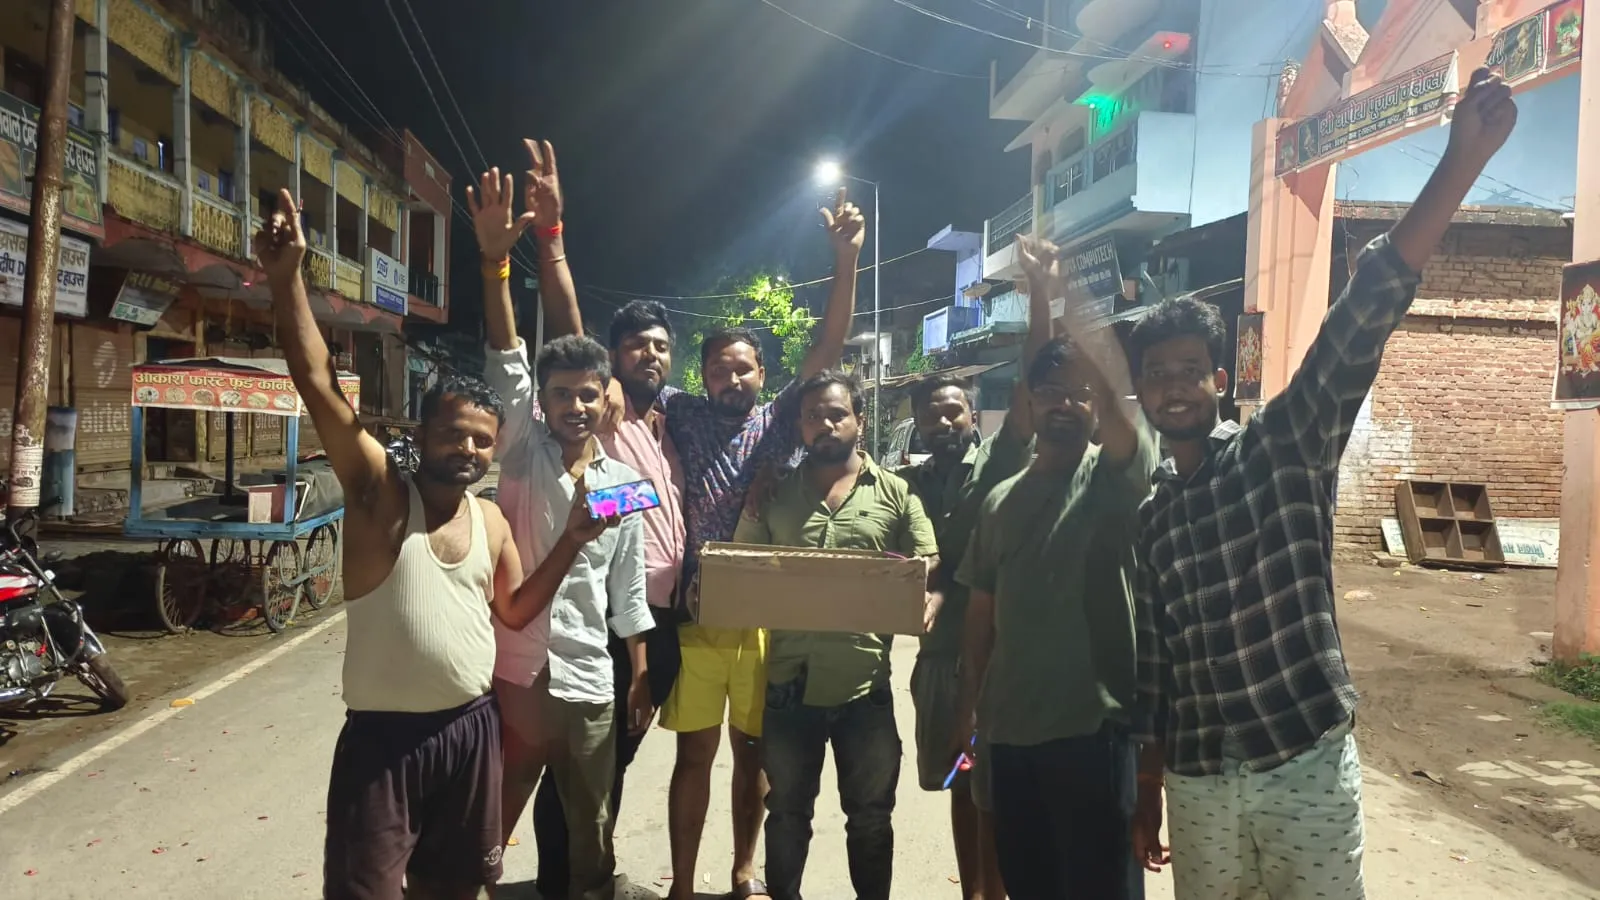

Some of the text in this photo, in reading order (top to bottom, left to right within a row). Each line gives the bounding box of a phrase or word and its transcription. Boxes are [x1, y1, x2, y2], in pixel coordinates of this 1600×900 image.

[0, 106, 20, 143] वाल
[135, 372, 185, 385] आकाश
[80, 402, 129, 433] airtel
